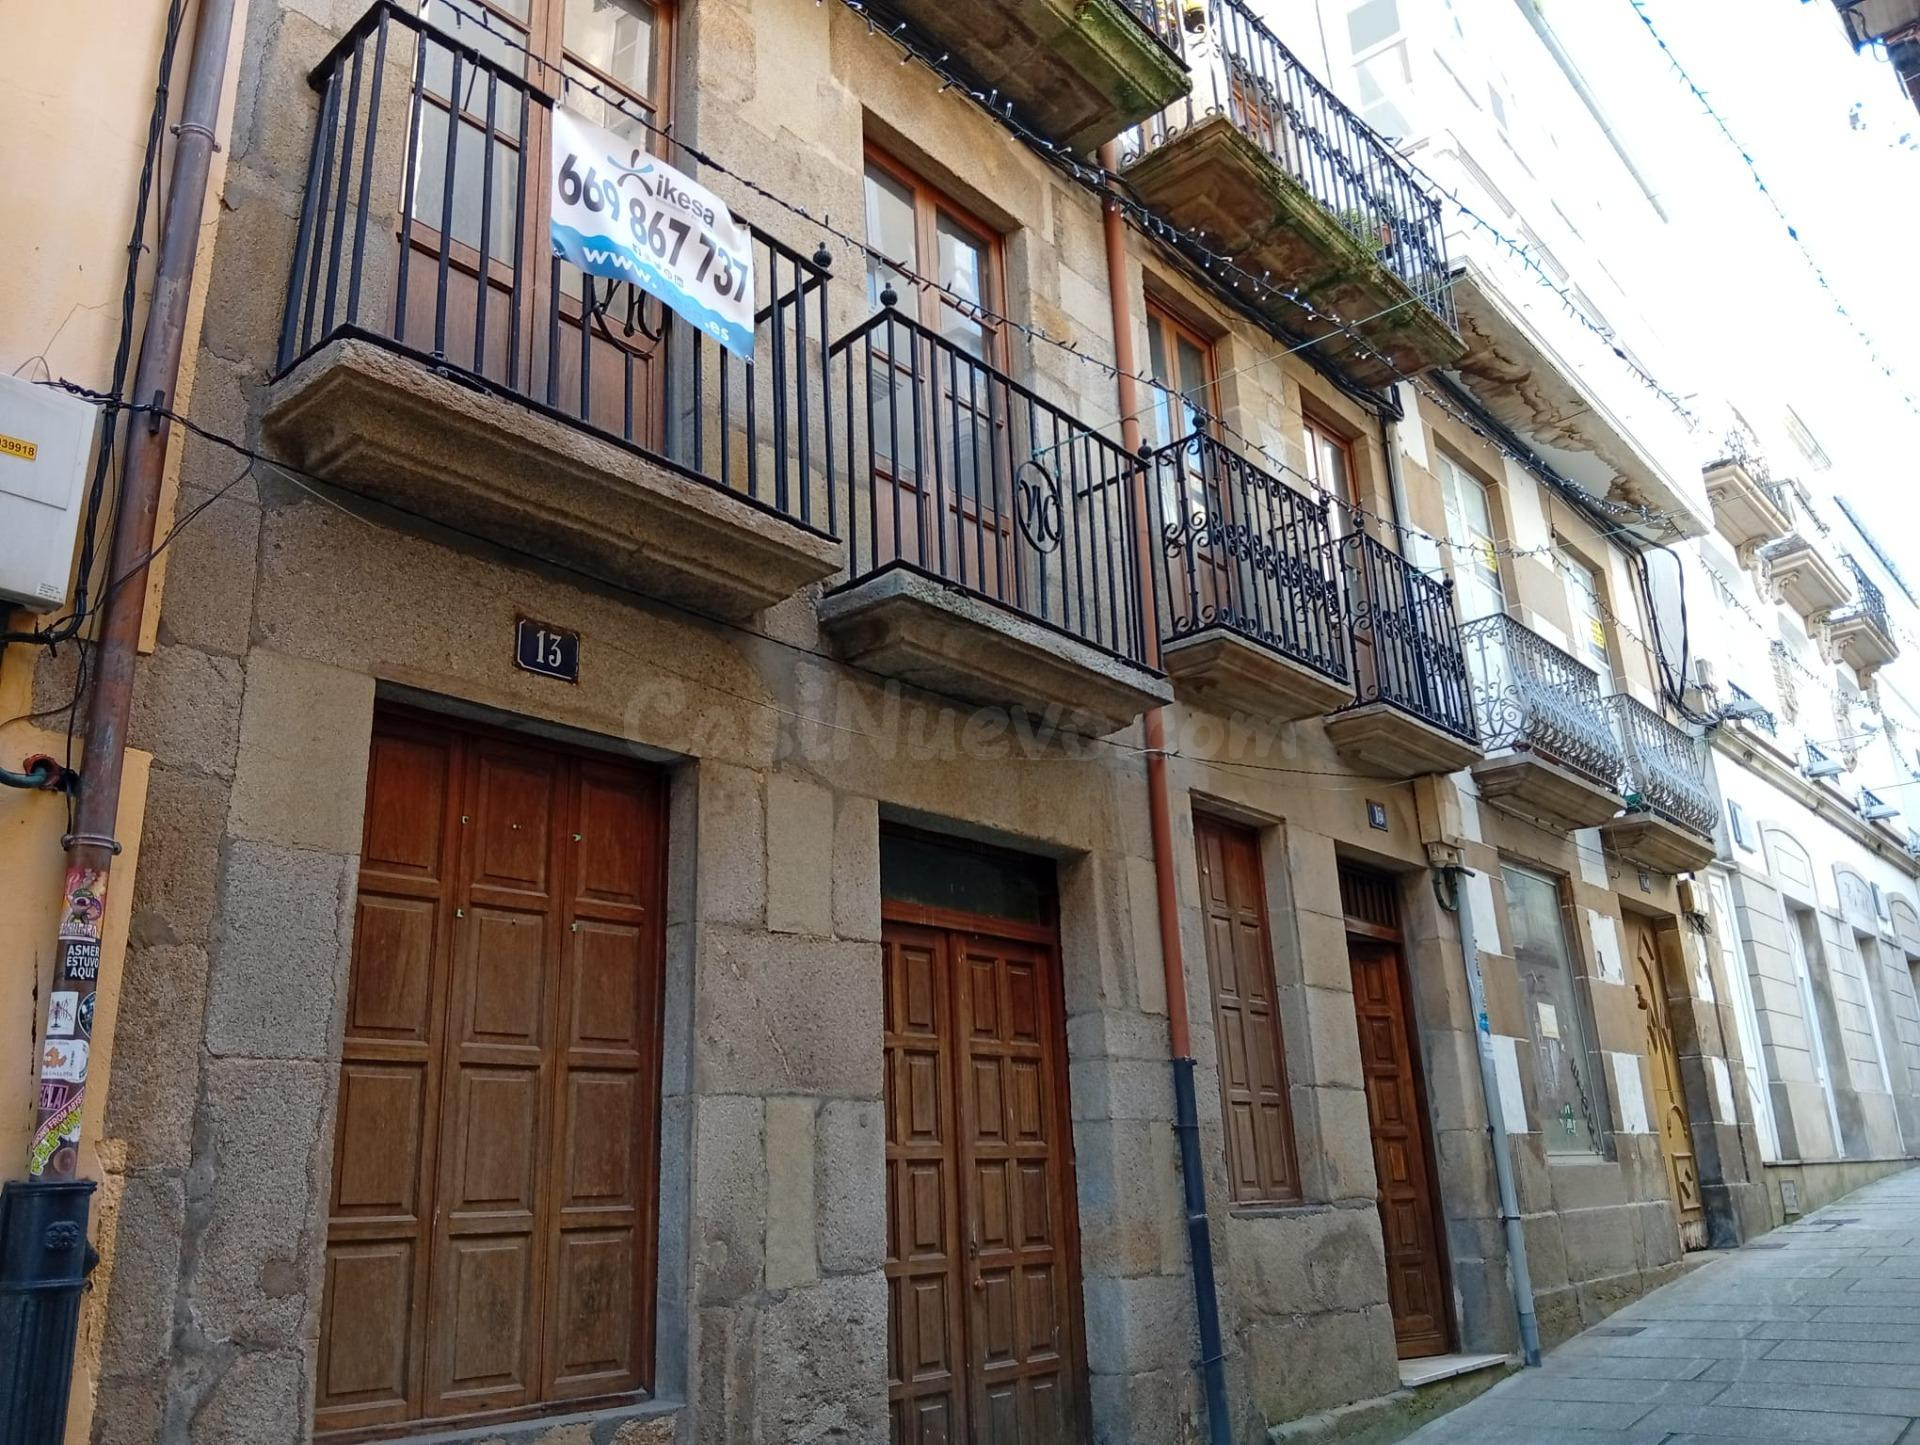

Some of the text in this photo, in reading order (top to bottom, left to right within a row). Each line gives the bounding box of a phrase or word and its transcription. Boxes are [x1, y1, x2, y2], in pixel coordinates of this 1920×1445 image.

[558, 153, 748, 303] 669 867 737
[0, 437, 35, 457] 39918
[536, 630, 562, 668] 13
[67, 944, 100, 958] ASMER
[66, 955, 99, 968] ESTUVO
[69, 967, 95, 980] AQUI
[48, 1109, 67, 1128] FROM
